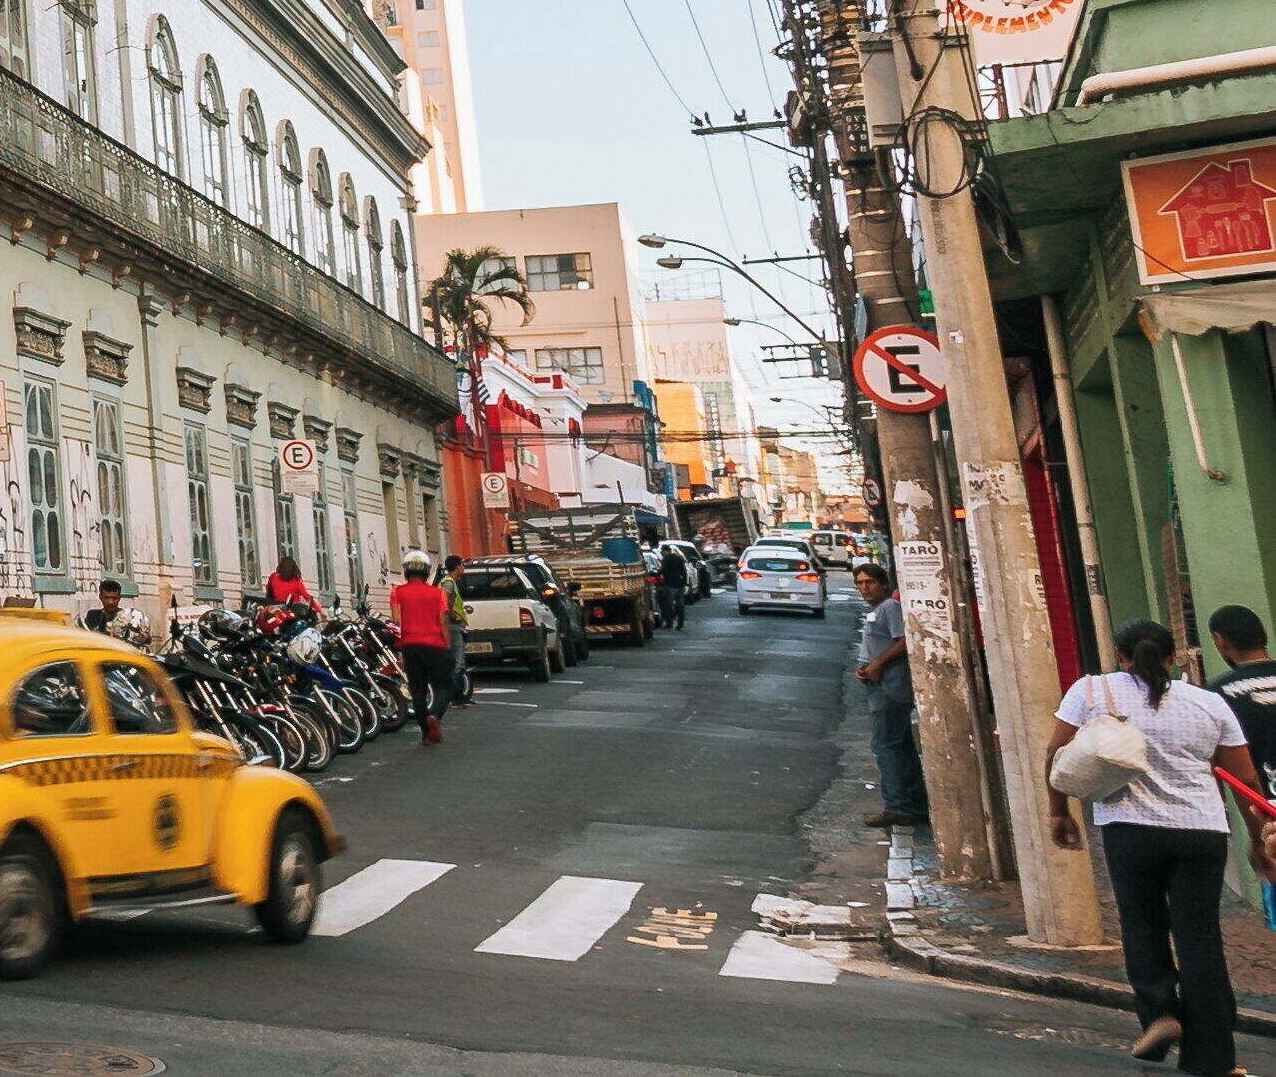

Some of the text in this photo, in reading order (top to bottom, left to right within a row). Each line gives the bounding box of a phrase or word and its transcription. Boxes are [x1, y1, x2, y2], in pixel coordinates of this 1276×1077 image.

[885, 345, 926, 393] E
[292, 448, 303, 463] E
[490, 479, 497, 489] E
